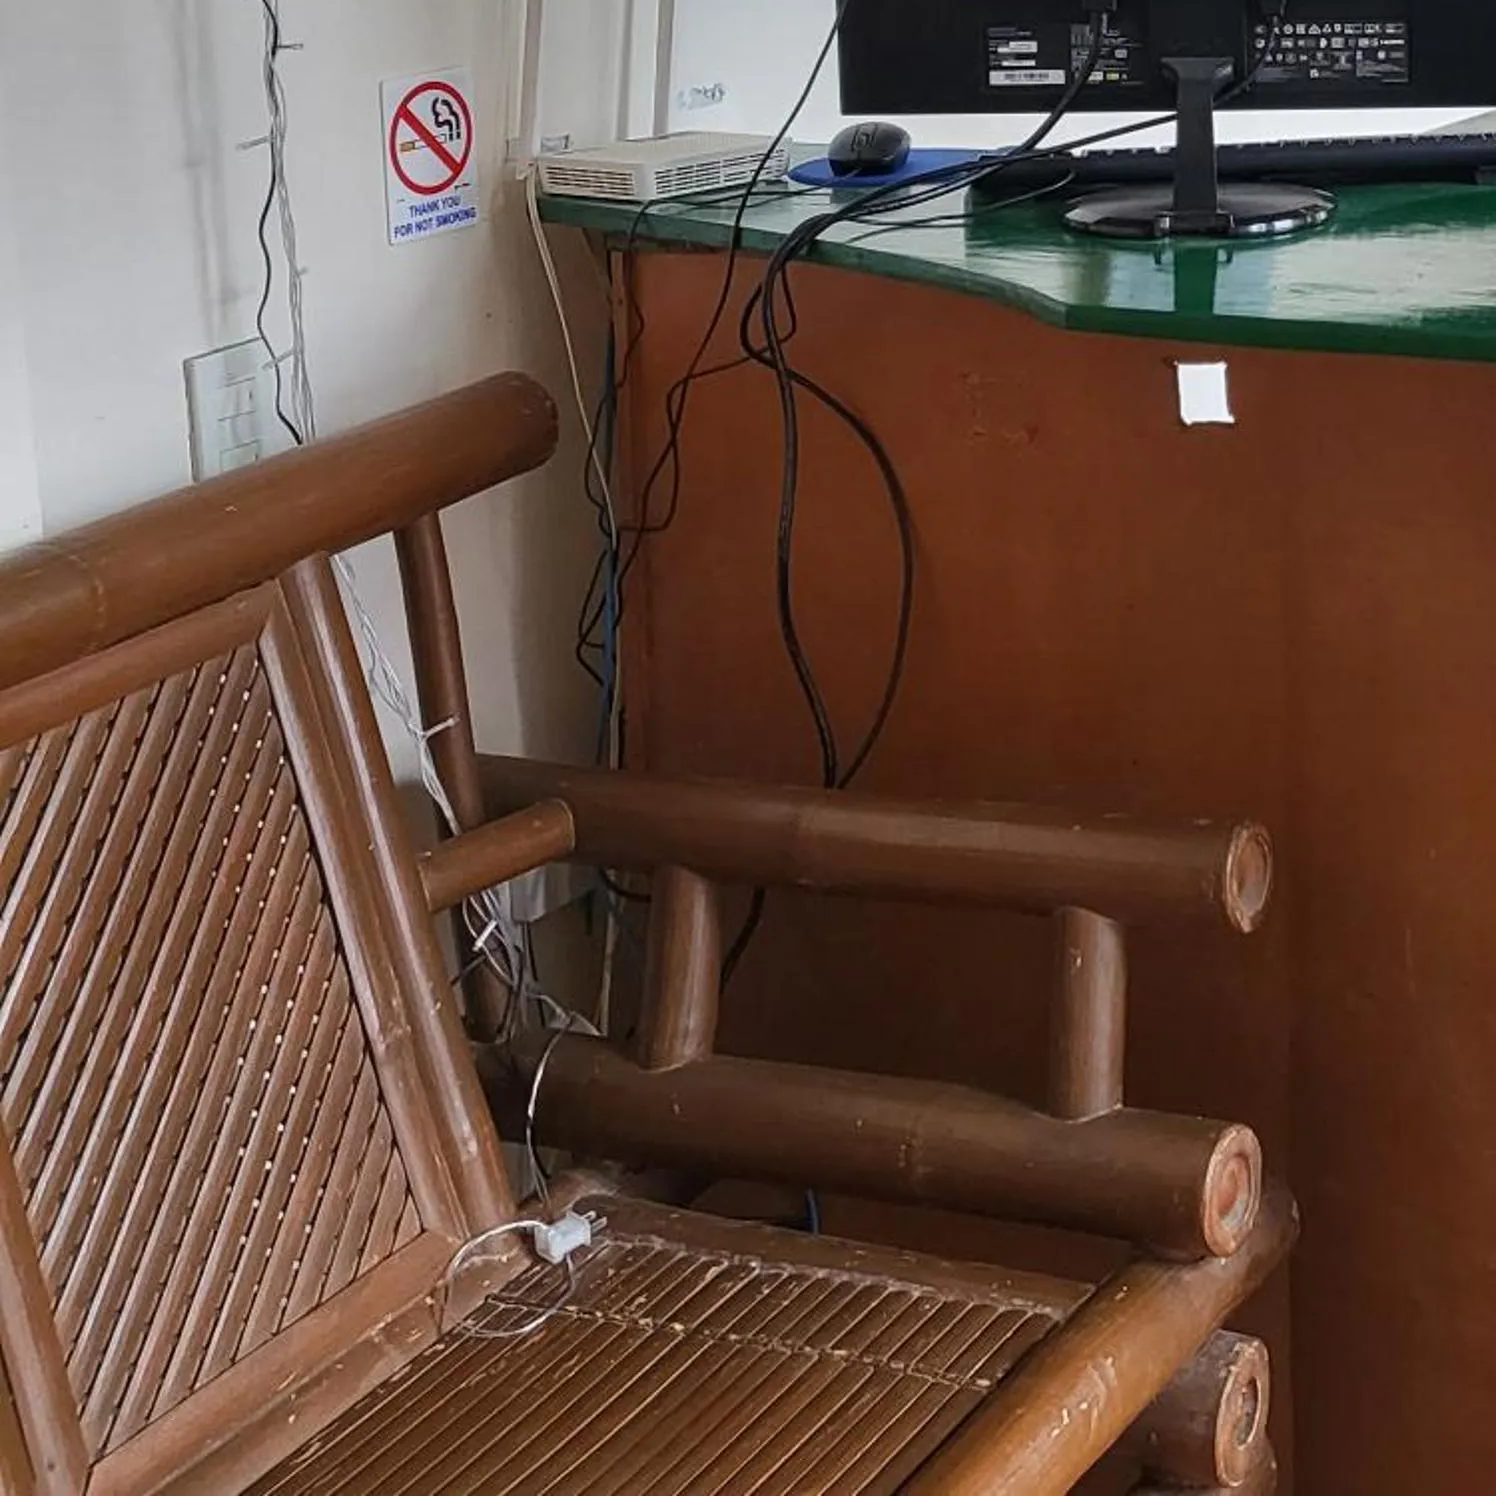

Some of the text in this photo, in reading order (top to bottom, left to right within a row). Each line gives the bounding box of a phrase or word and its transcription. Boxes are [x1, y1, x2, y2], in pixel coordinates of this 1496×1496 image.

[409, 196, 461, 217] THANK YOU
[394, 207, 476, 238] FOR NOT SMOKING
